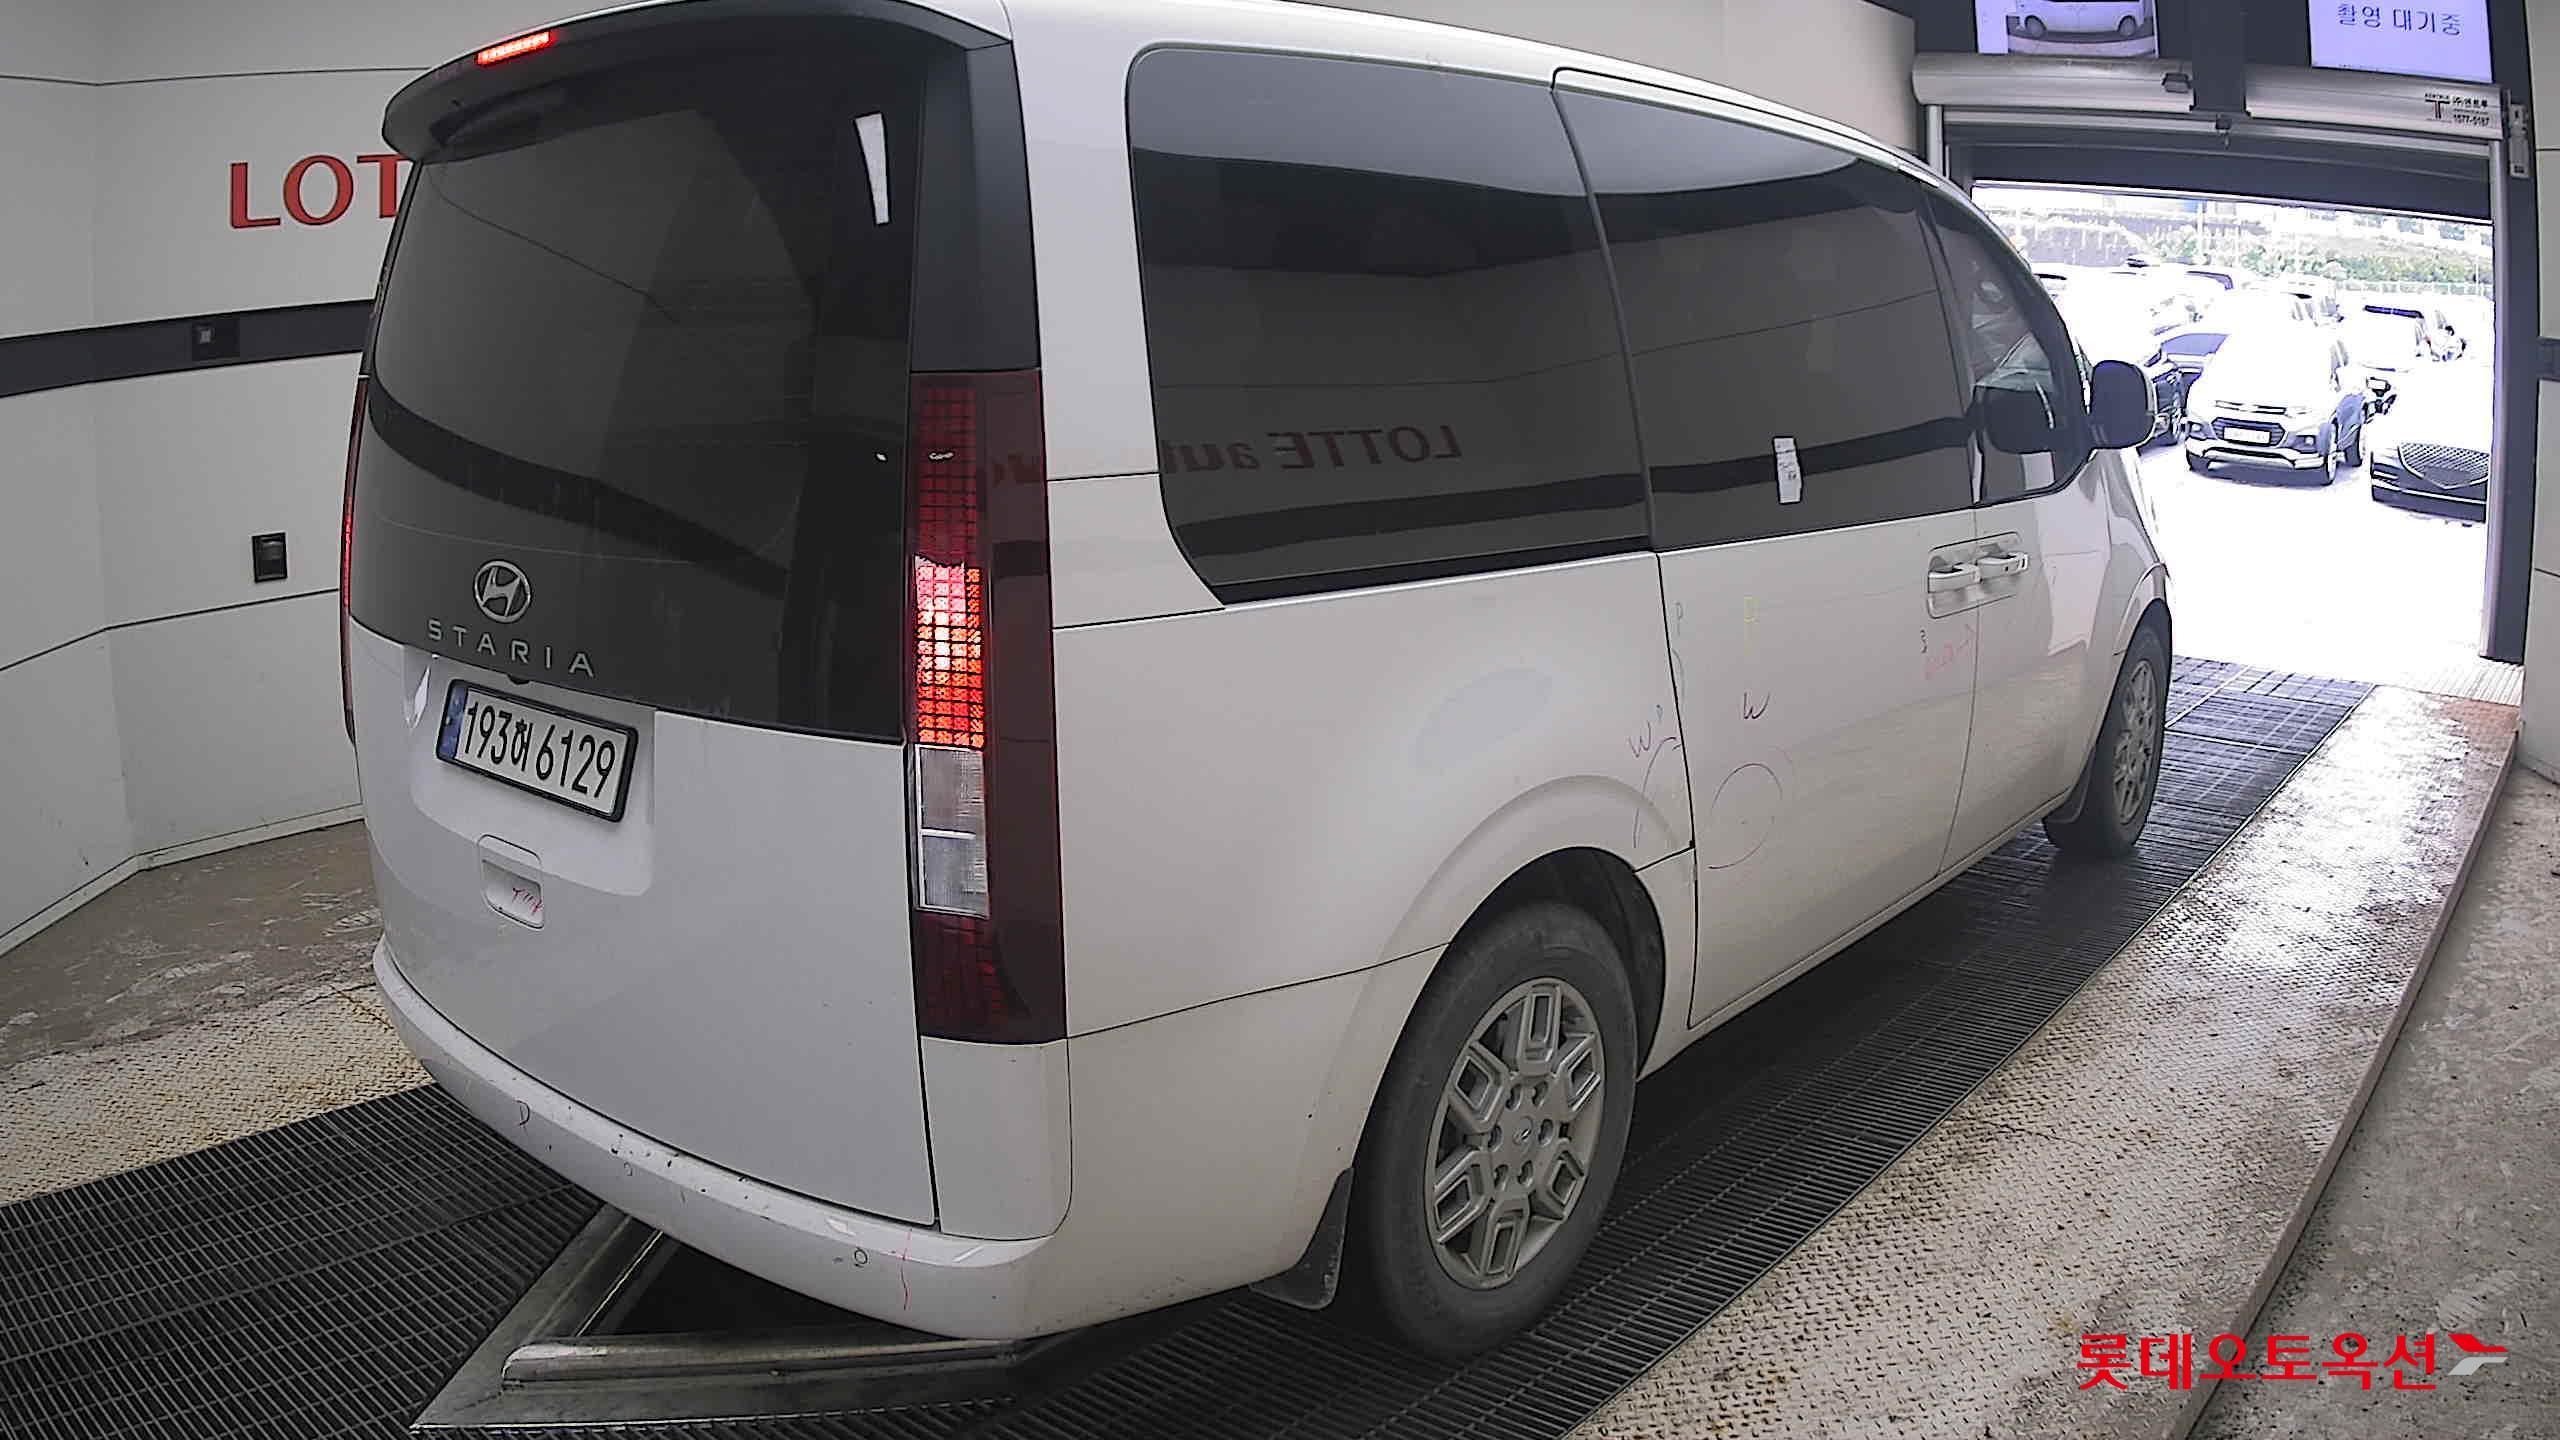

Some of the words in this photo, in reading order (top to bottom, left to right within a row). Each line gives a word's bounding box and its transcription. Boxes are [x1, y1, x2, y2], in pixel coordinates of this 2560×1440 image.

[2338, 3, 2382, 29] 촬영
[2392, 8, 2462, 36] 대기중
[231, 154, 410, 229] LOT
[427, 618, 595, 678] STARIA
[1743, 691, 1771, 720] W
